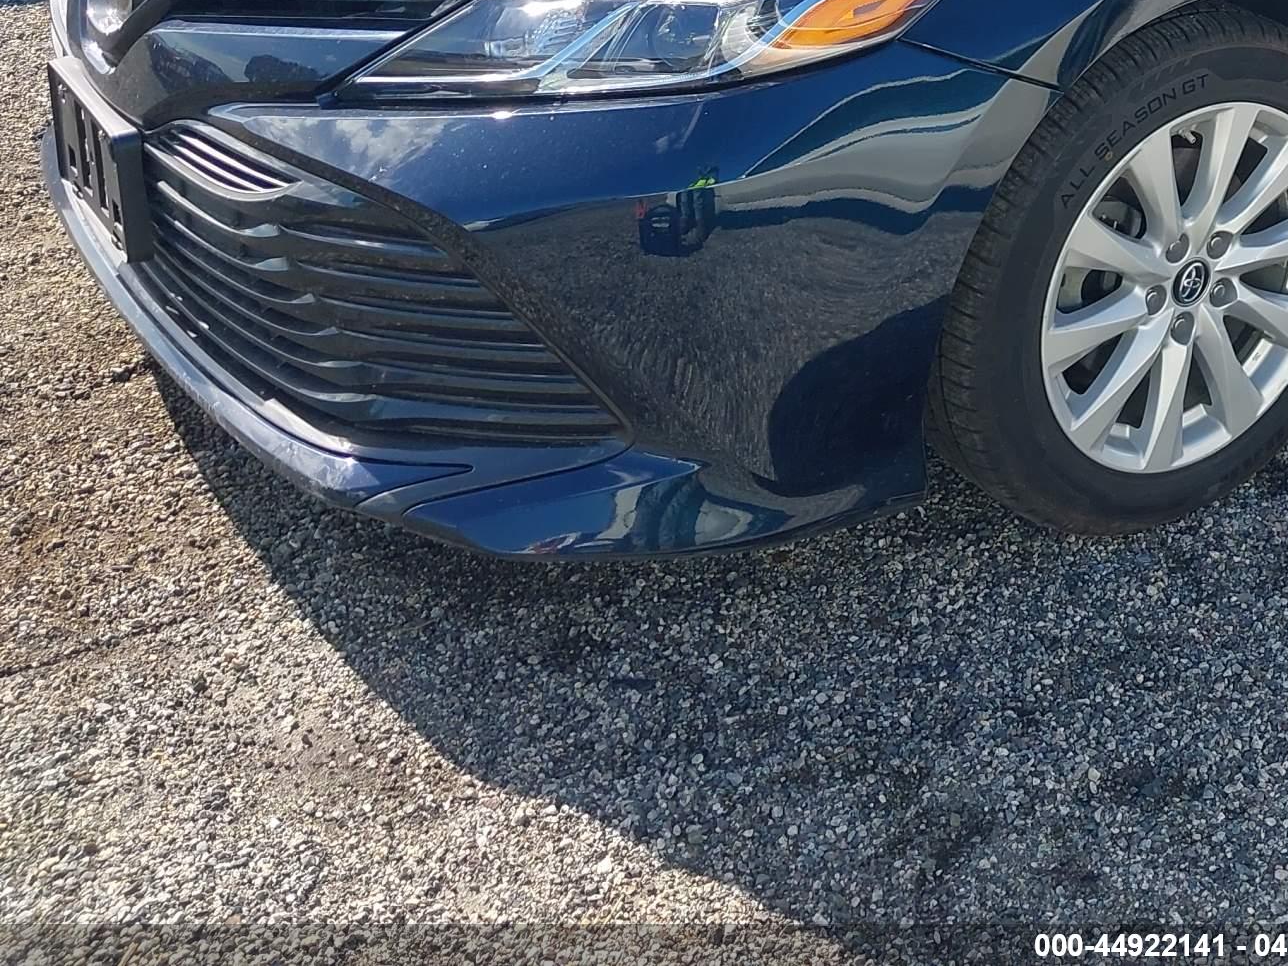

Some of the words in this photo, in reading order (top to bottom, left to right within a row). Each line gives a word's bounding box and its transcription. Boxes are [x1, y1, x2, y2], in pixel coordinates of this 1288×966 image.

[1061, 165, 1096, 208] ALL
[1094, 87, 1177, 161] SEASON
[1181, 73, 1209, 96] GT
